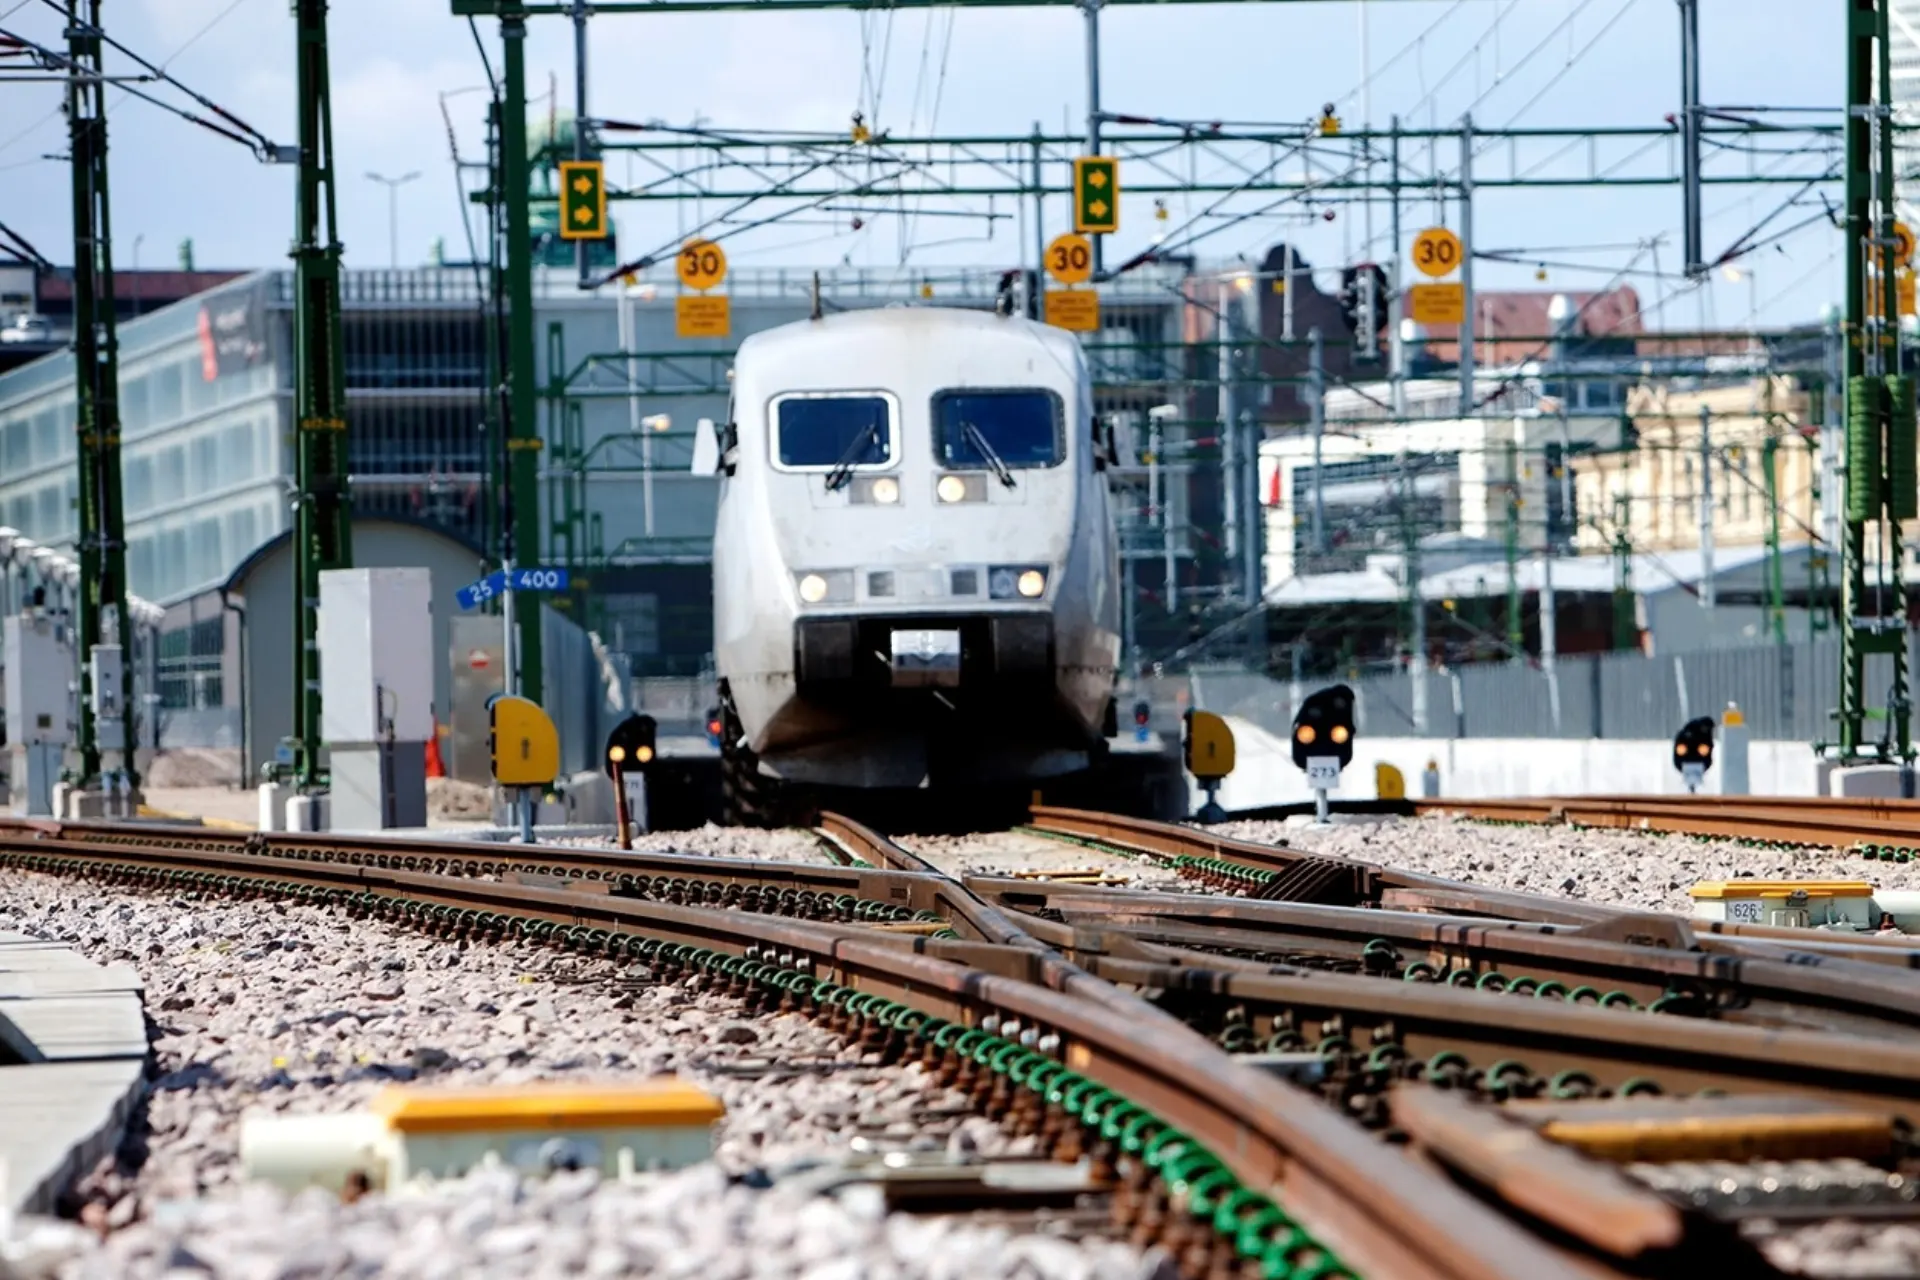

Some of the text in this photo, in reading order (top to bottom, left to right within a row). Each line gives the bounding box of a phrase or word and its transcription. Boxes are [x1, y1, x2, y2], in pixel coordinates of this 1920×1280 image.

[684, 249, 719, 276] 30
[1053, 245, 1089, 271] 30
[1420, 238, 1455, 265] 30
[469, 570, 559, 602] 25 400
[1310, 766, 1337, 778] 273
[1734, 903, 1757, 918] 626
